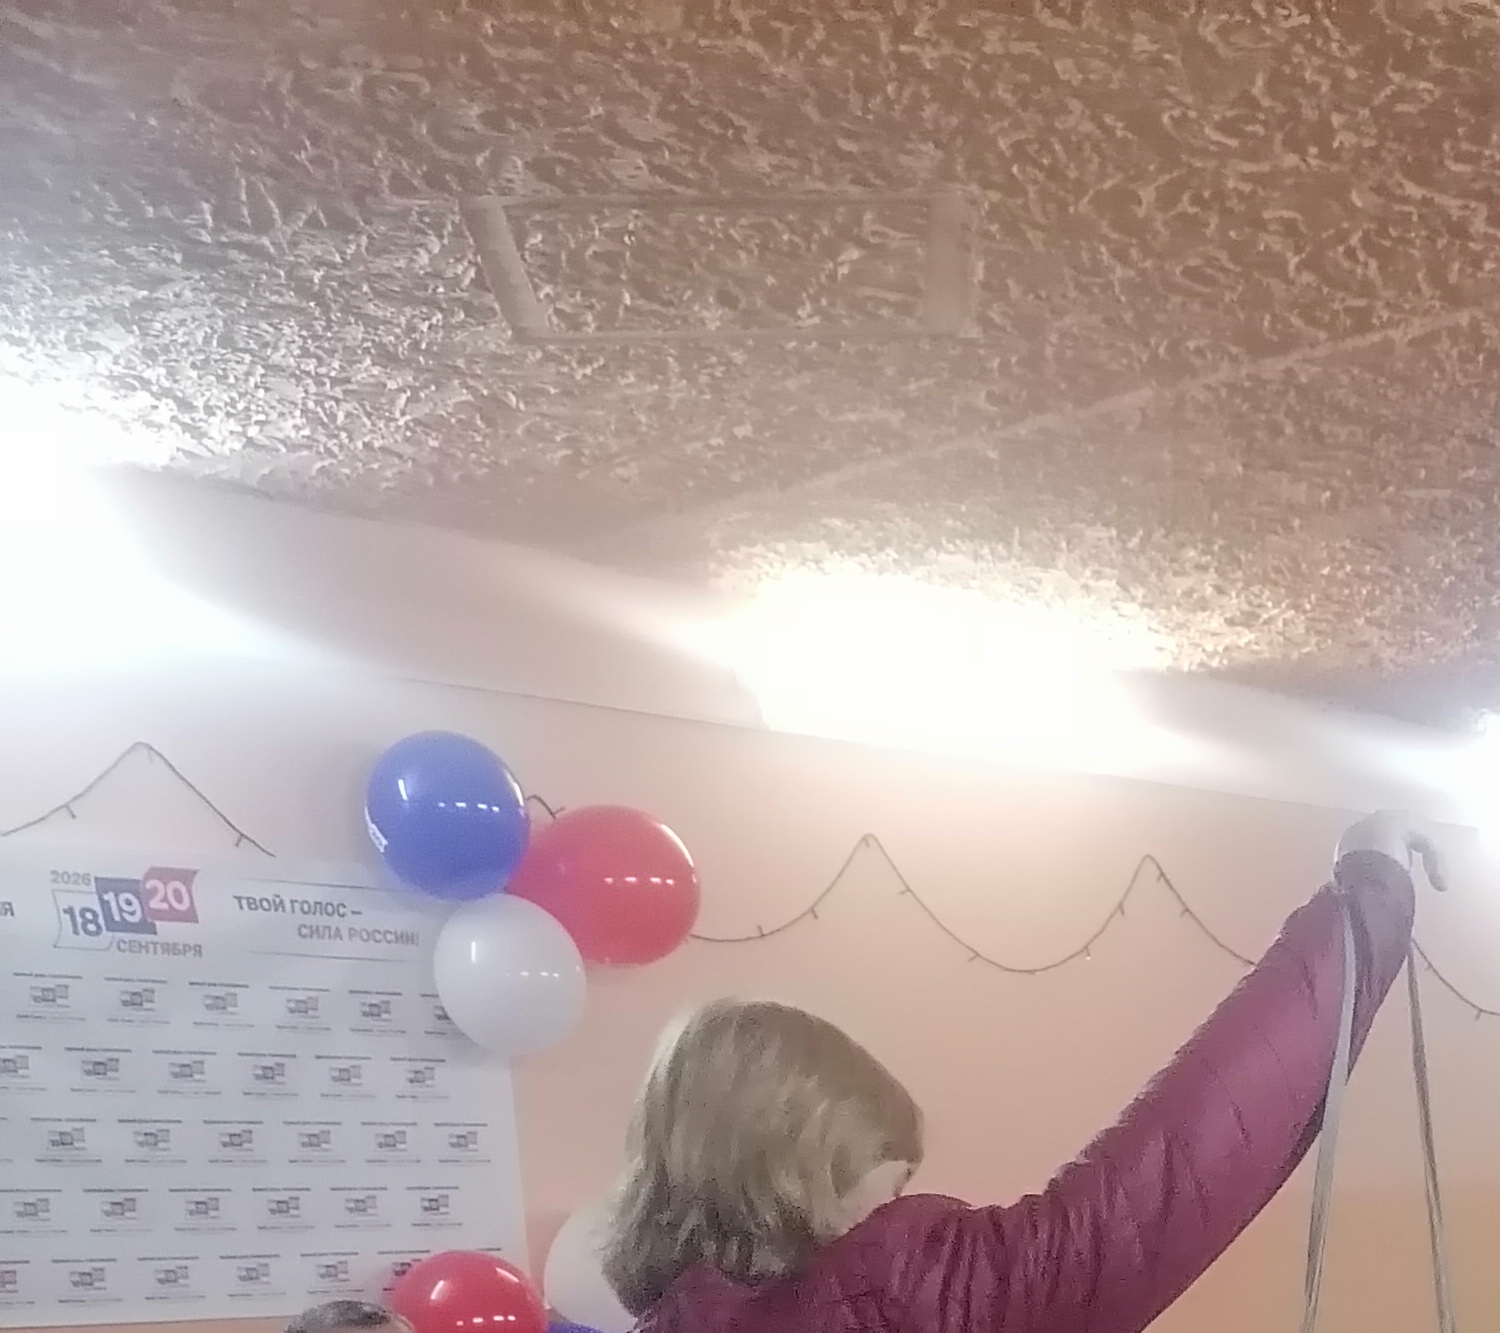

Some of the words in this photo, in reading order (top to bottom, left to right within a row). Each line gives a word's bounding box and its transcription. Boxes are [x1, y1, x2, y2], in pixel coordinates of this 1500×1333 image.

[50, 870, 92, 886] 2026
[62, 905, 103, 937] 18
[103, 891, 143, 923] 19
[145, 879, 190, 912] 20
[233, 894, 286, 913] ТВОЙ
[290, 899, 348, 918] ГОЛОС
[297, 924, 344, 942] СИЛА
[348, 926, 420, 947] РОССИИ!
[116, 939, 204, 958] СЕНТЯБРЯ
